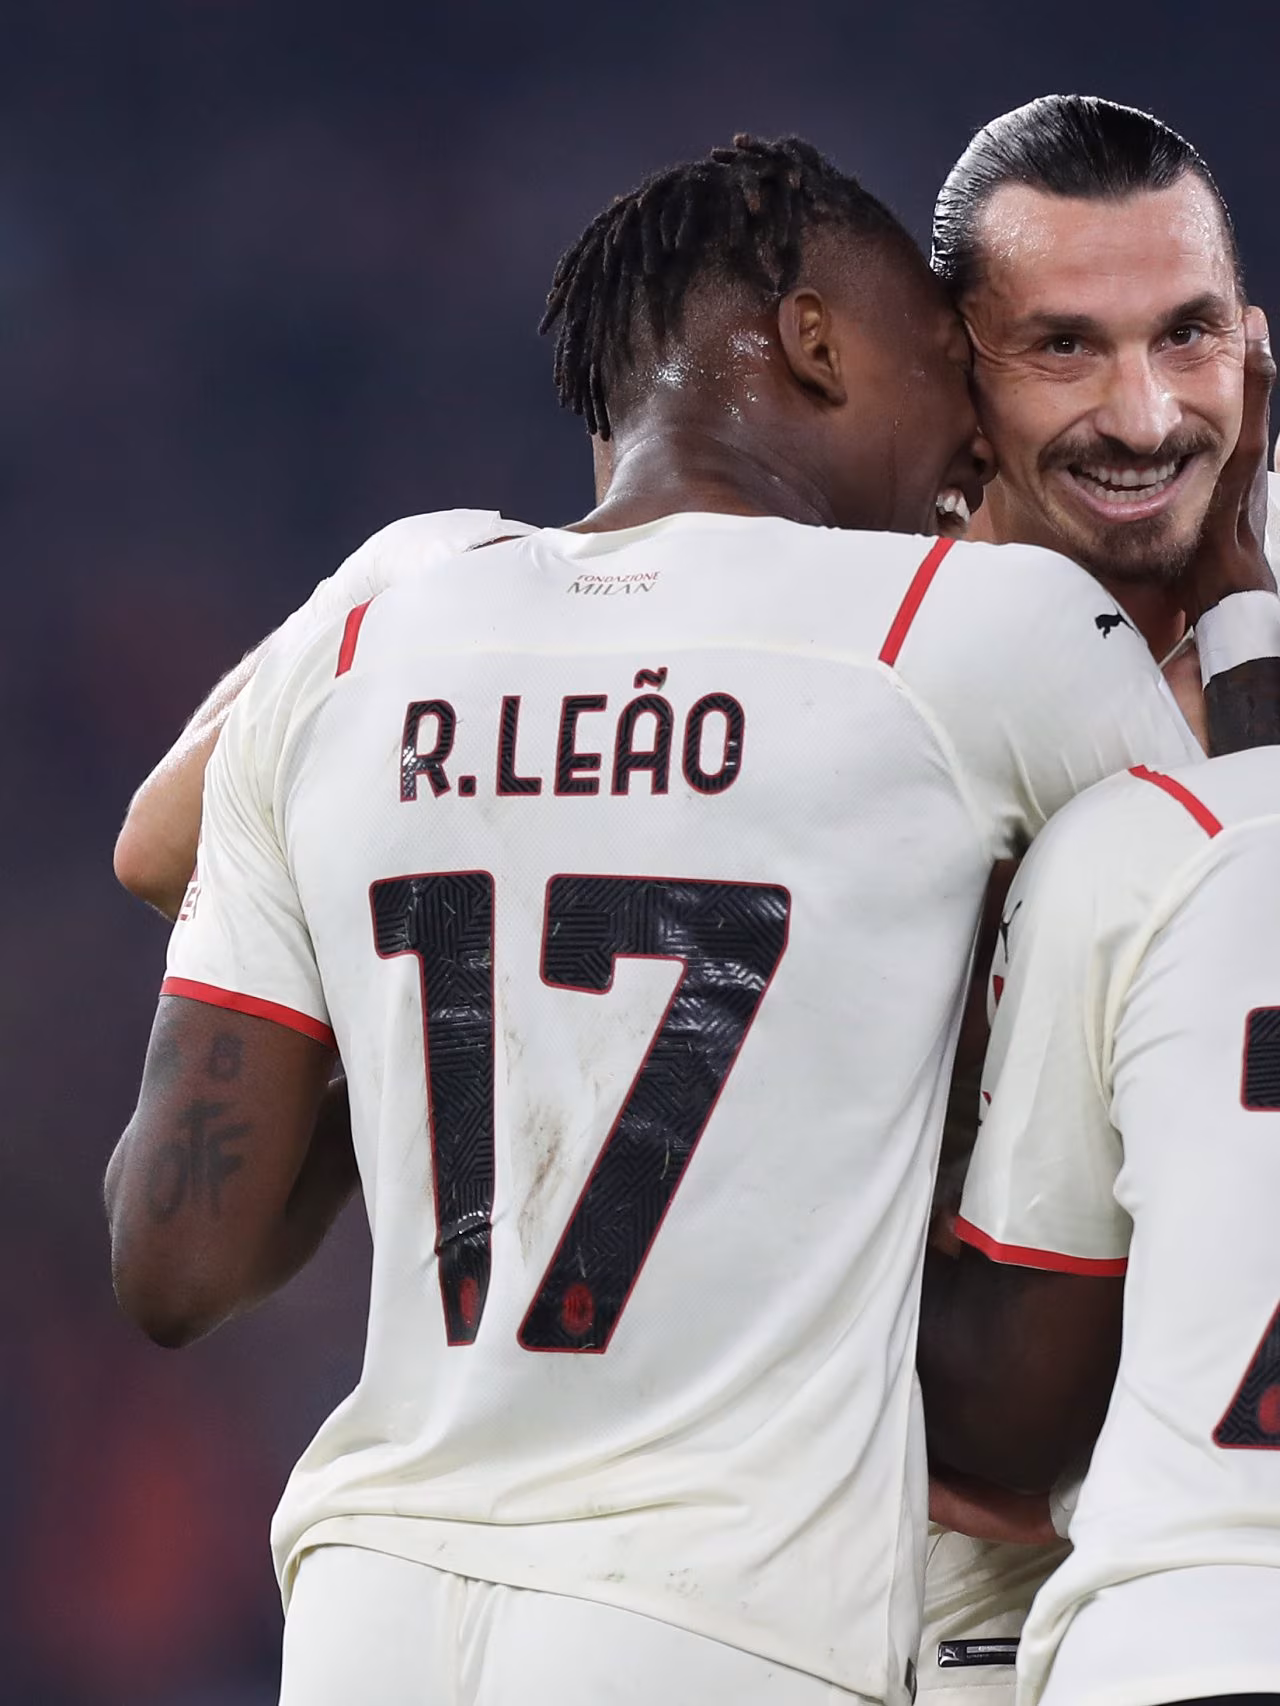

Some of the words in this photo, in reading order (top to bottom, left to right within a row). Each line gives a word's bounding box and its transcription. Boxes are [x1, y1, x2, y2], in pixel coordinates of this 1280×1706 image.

[566, 581, 656, 596] MILAN
[577, 571, 661, 583] FONDAZIONE
[400, 667, 745, 802] R.LEÃO
[369, 870, 791, 1354] 17
